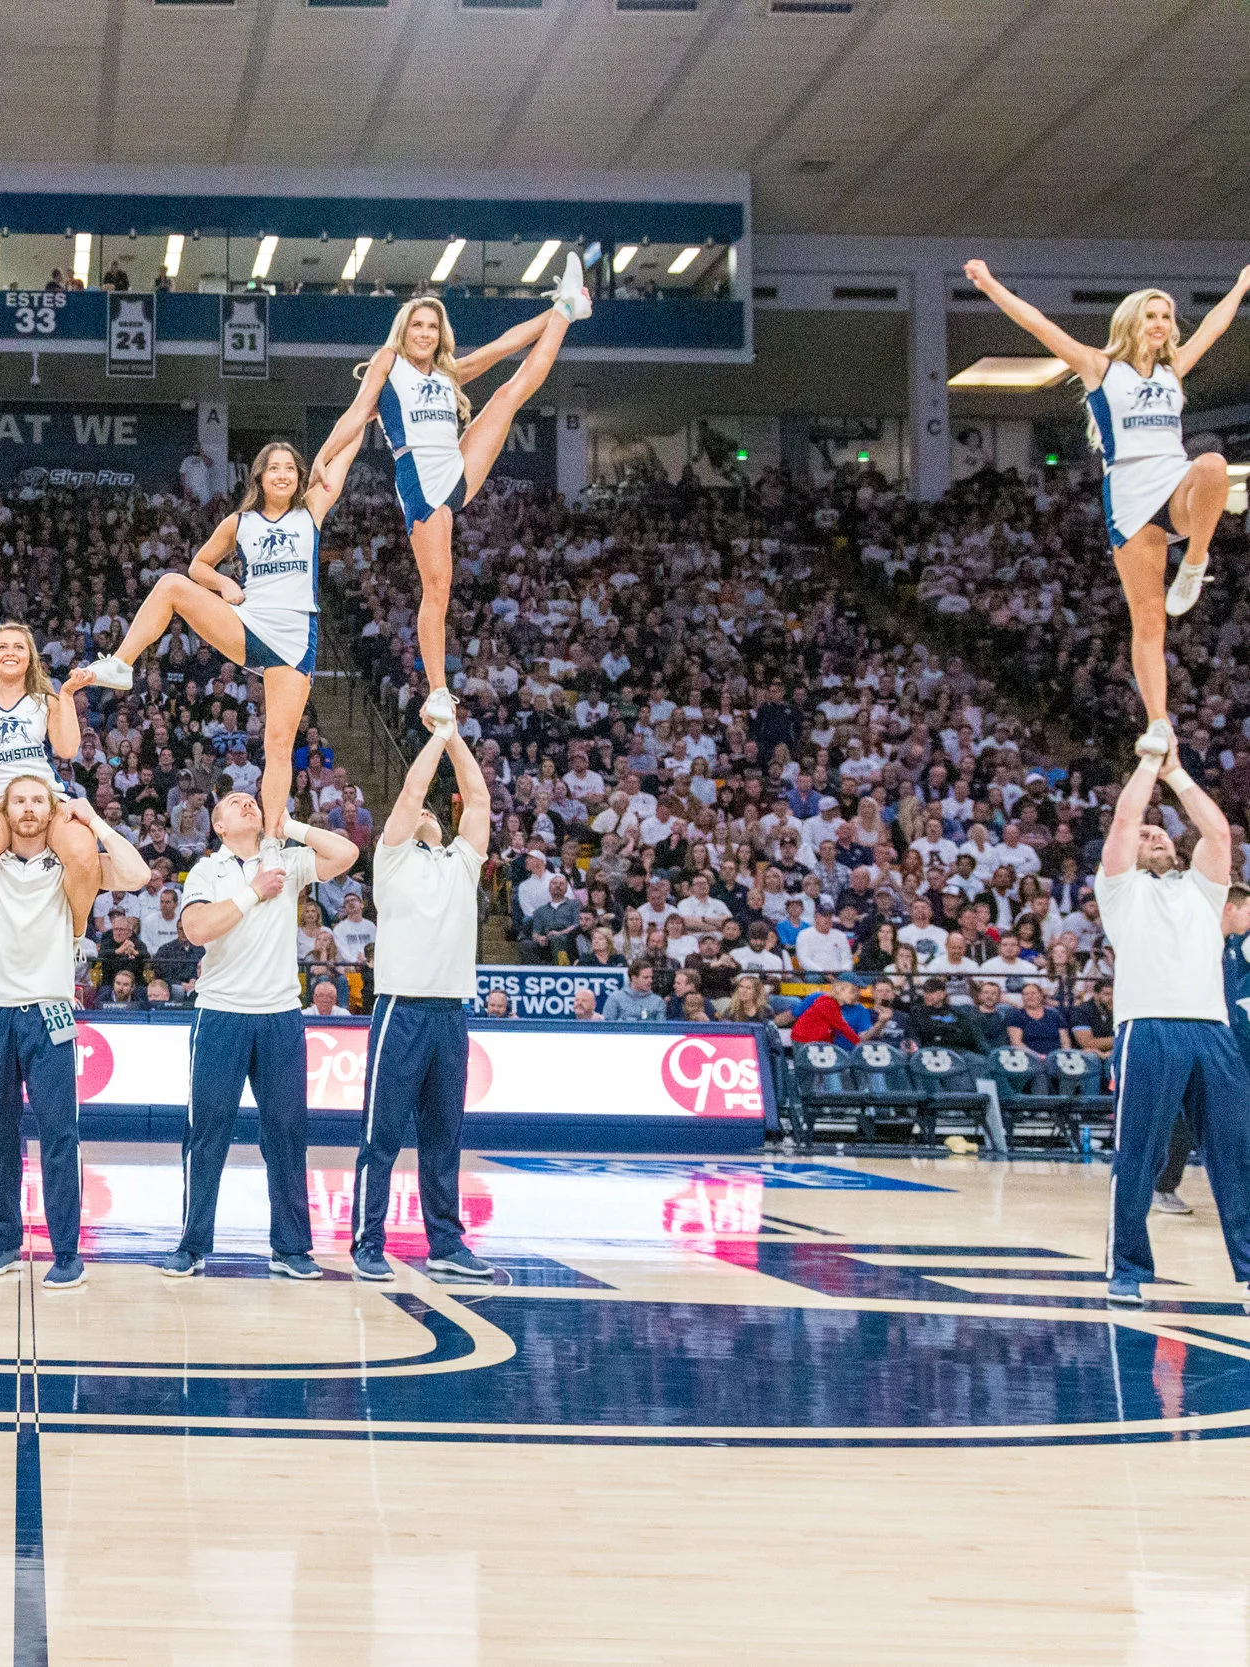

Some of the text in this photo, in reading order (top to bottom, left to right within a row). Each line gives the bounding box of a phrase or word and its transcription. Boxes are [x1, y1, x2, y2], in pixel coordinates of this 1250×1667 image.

[5, 292, 67, 308] ESTES
[15, 307, 56, 333] 33
[116, 331, 146, 351] 24
[231, 332, 258, 351] 31
[206, 408, 221, 425] A
[410, 409, 437, 423] UTAH
[73, 414, 138, 446] WE
[96, 469, 136, 486] Pro
[252, 560, 308, 577] UTAH STATE
[14, 746, 45, 760] STATE
[476, 975, 619, 996] CBS SPORTS
